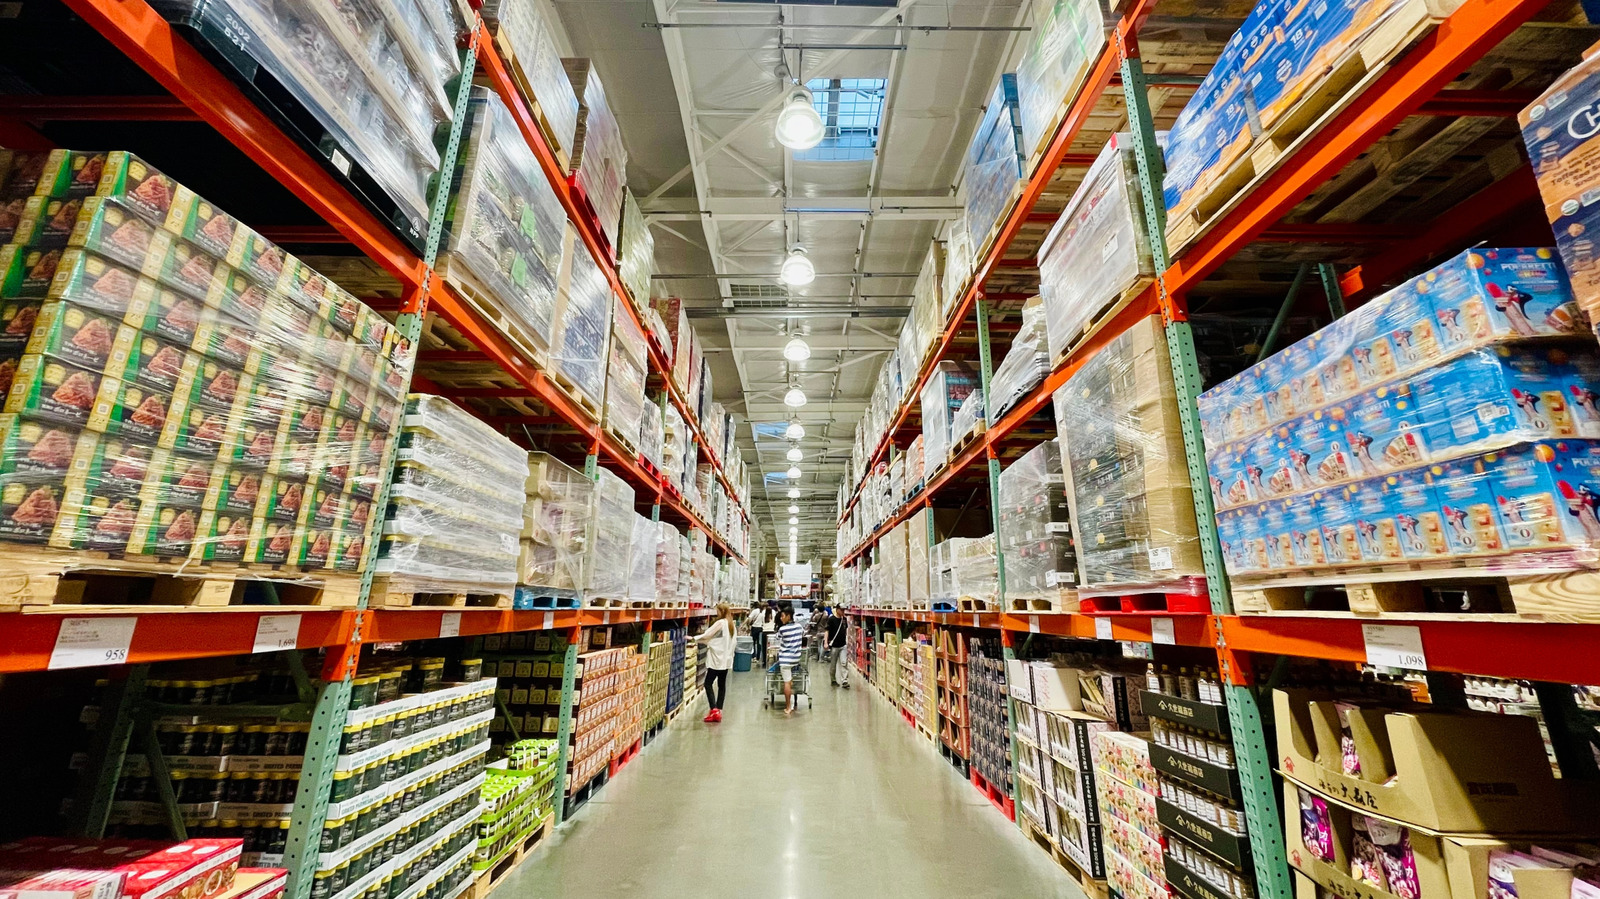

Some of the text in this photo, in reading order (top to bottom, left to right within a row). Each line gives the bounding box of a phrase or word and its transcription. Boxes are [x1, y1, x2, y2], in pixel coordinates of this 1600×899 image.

[225, 13, 251, 43] 2002
[1290, 28, 1304, 44] 18
[105, 648, 126, 661] 958
[1398, 655, 1424, 666] 1,098
